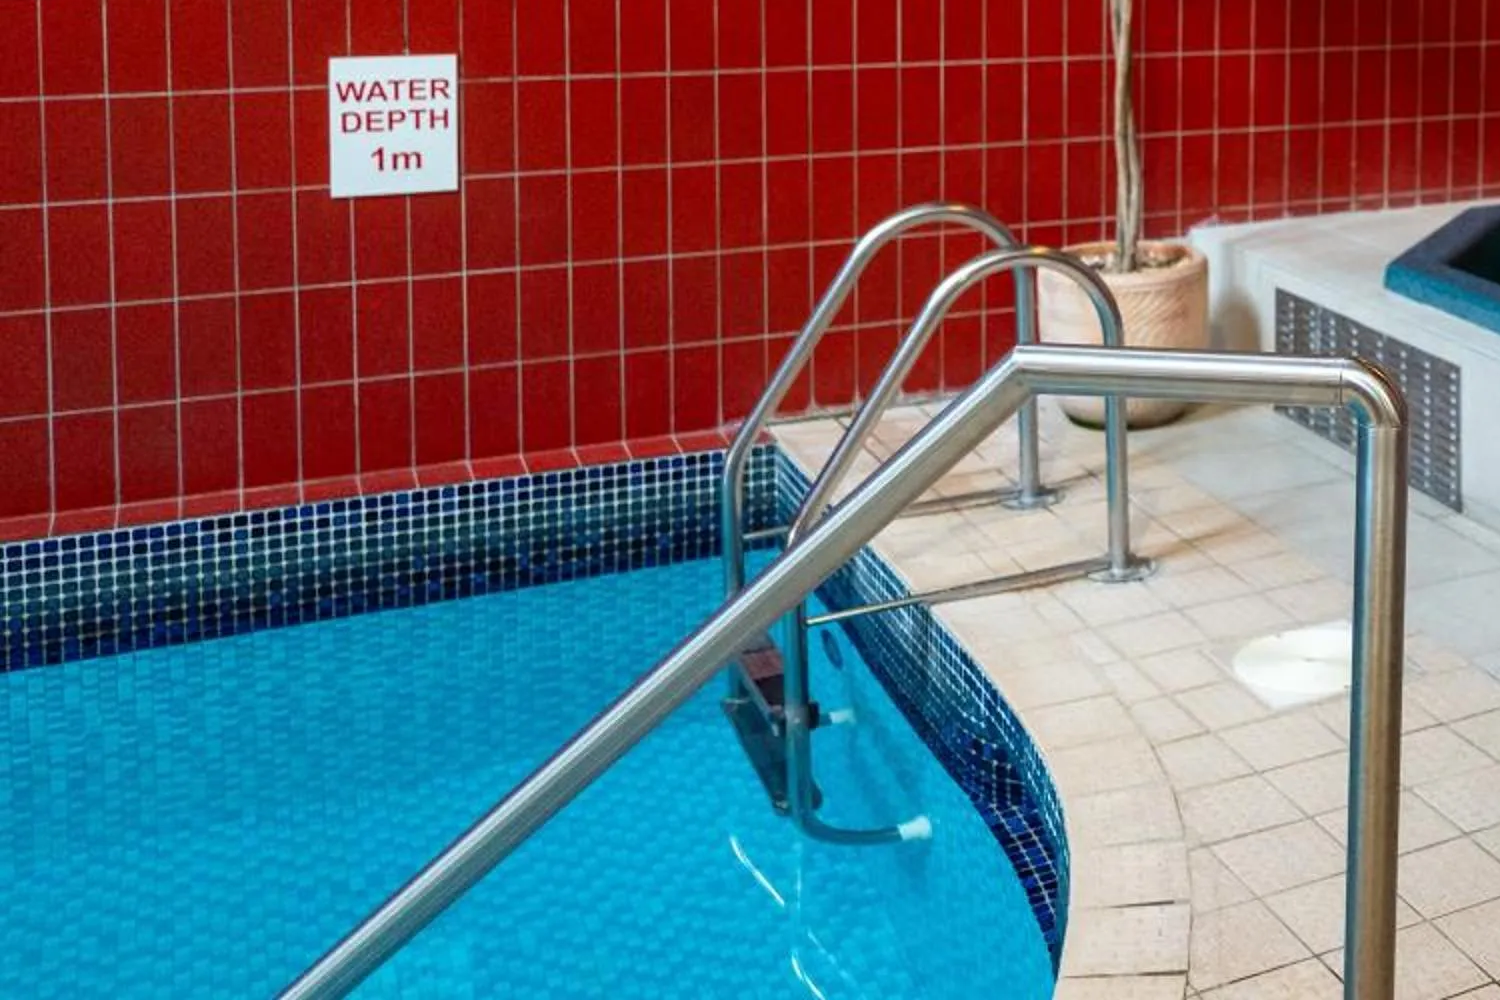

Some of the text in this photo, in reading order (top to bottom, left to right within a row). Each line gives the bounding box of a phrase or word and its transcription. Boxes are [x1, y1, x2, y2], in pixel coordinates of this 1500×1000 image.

[335, 77, 450, 103] WATER
[340, 108, 450, 134] DEPTH
[370, 146, 423, 172] 1m
